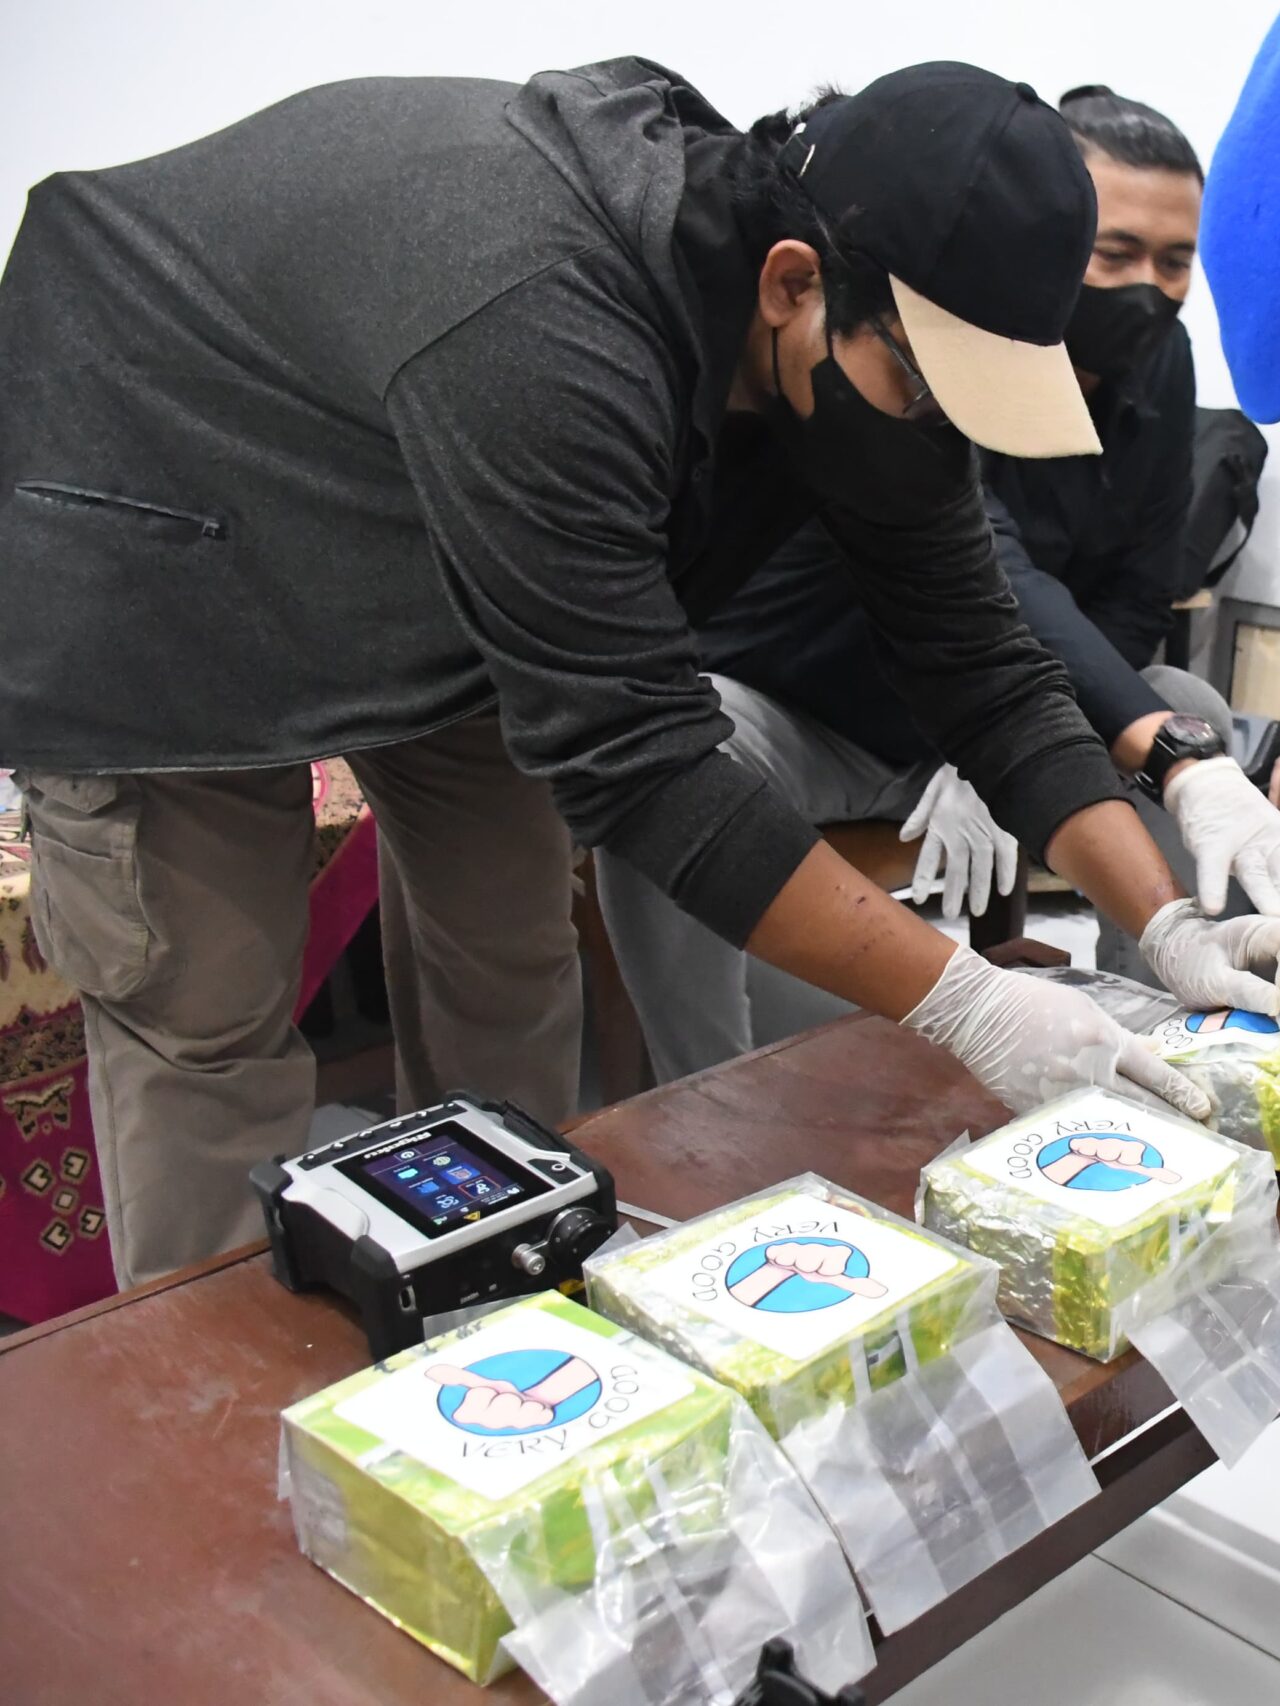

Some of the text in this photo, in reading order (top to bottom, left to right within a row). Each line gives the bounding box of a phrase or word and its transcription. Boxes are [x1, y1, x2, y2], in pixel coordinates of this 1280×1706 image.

[1164, 1018, 1193, 1048] GOOD
[1007, 1120, 1131, 1179] VERY GOOD
[692, 1221, 839, 1301] VERY GOOD
[462, 1365, 639, 1458] VERY GOOD
